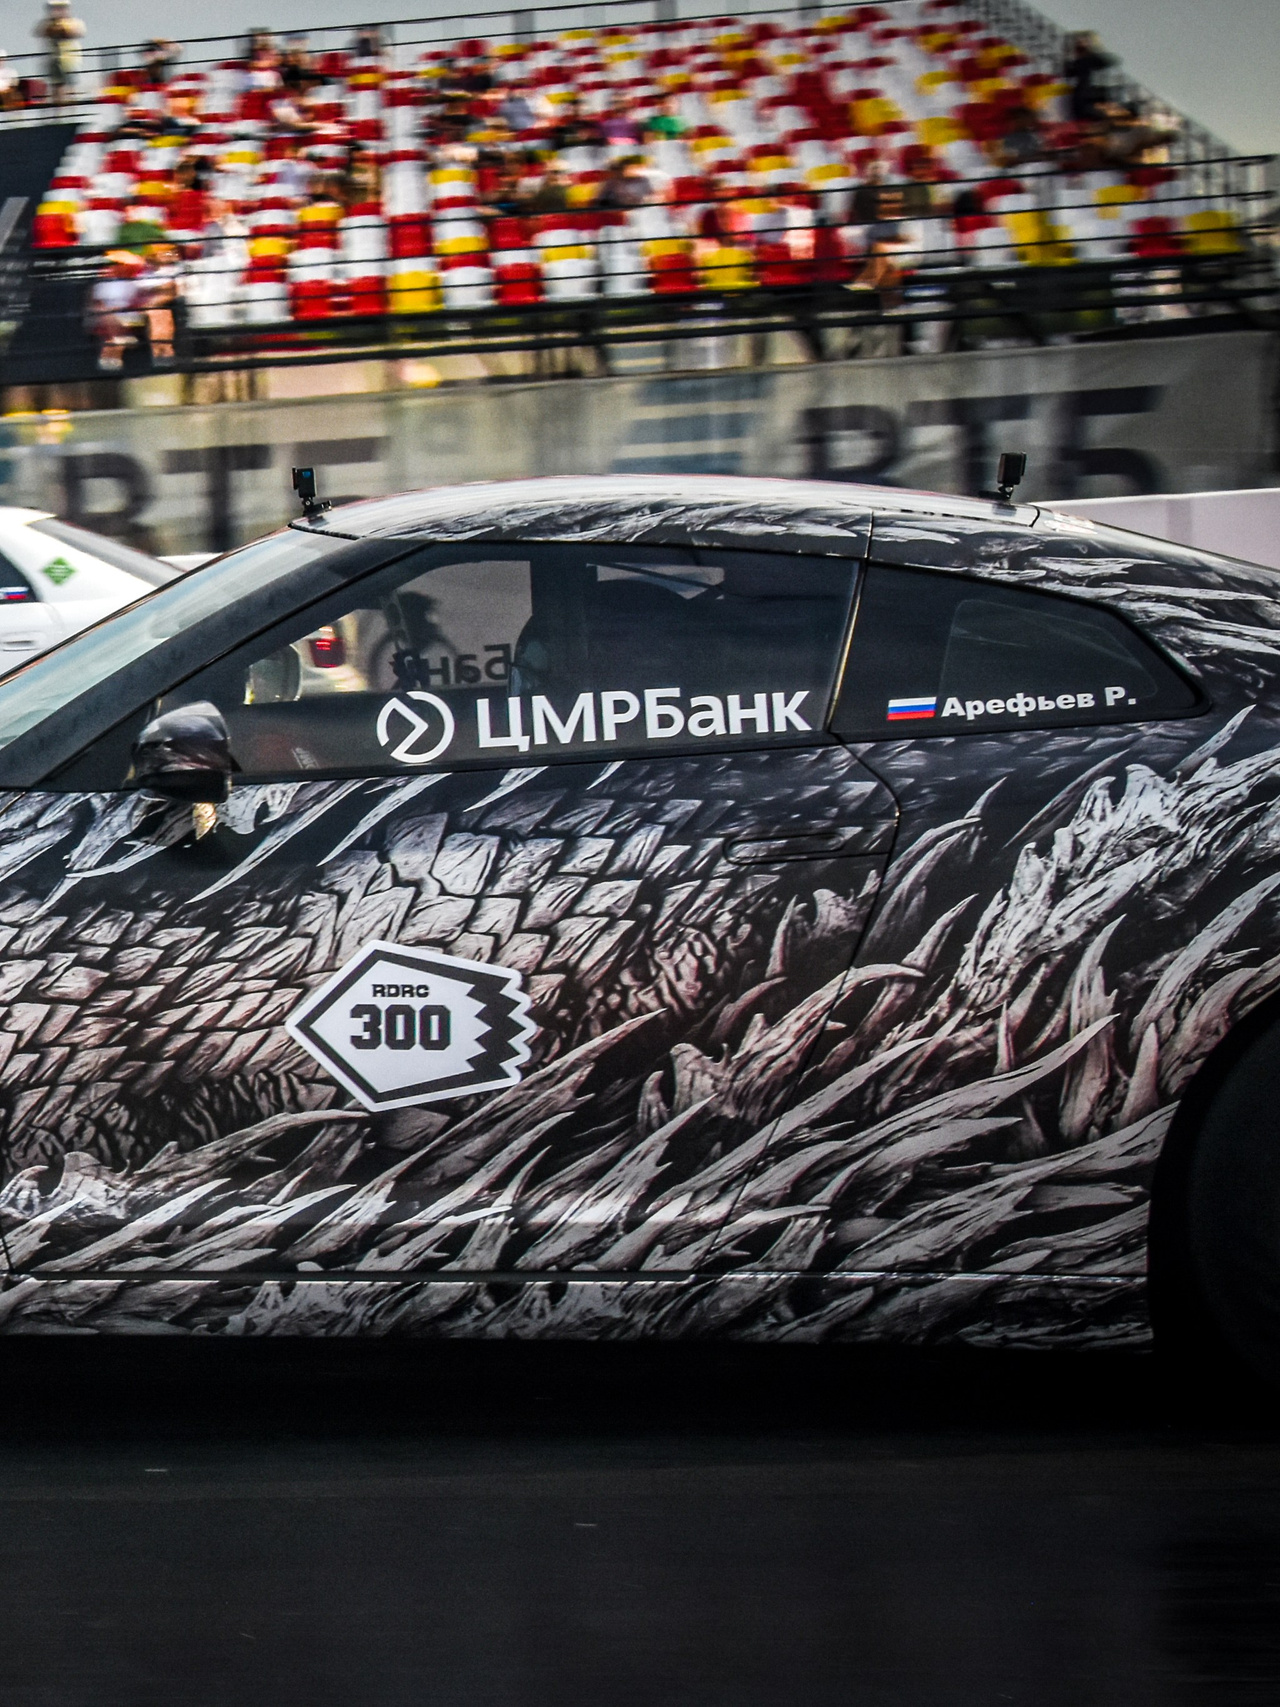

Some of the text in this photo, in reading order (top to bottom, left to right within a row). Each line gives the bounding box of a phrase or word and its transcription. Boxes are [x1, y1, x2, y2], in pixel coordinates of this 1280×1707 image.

[476, 688, 813, 752] ЦМРБанк
[940, 686, 1137, 721] Арефьев Р.
[371, 983, 430, 998] RDRC
[349, 1004, 452, 1051] 300
